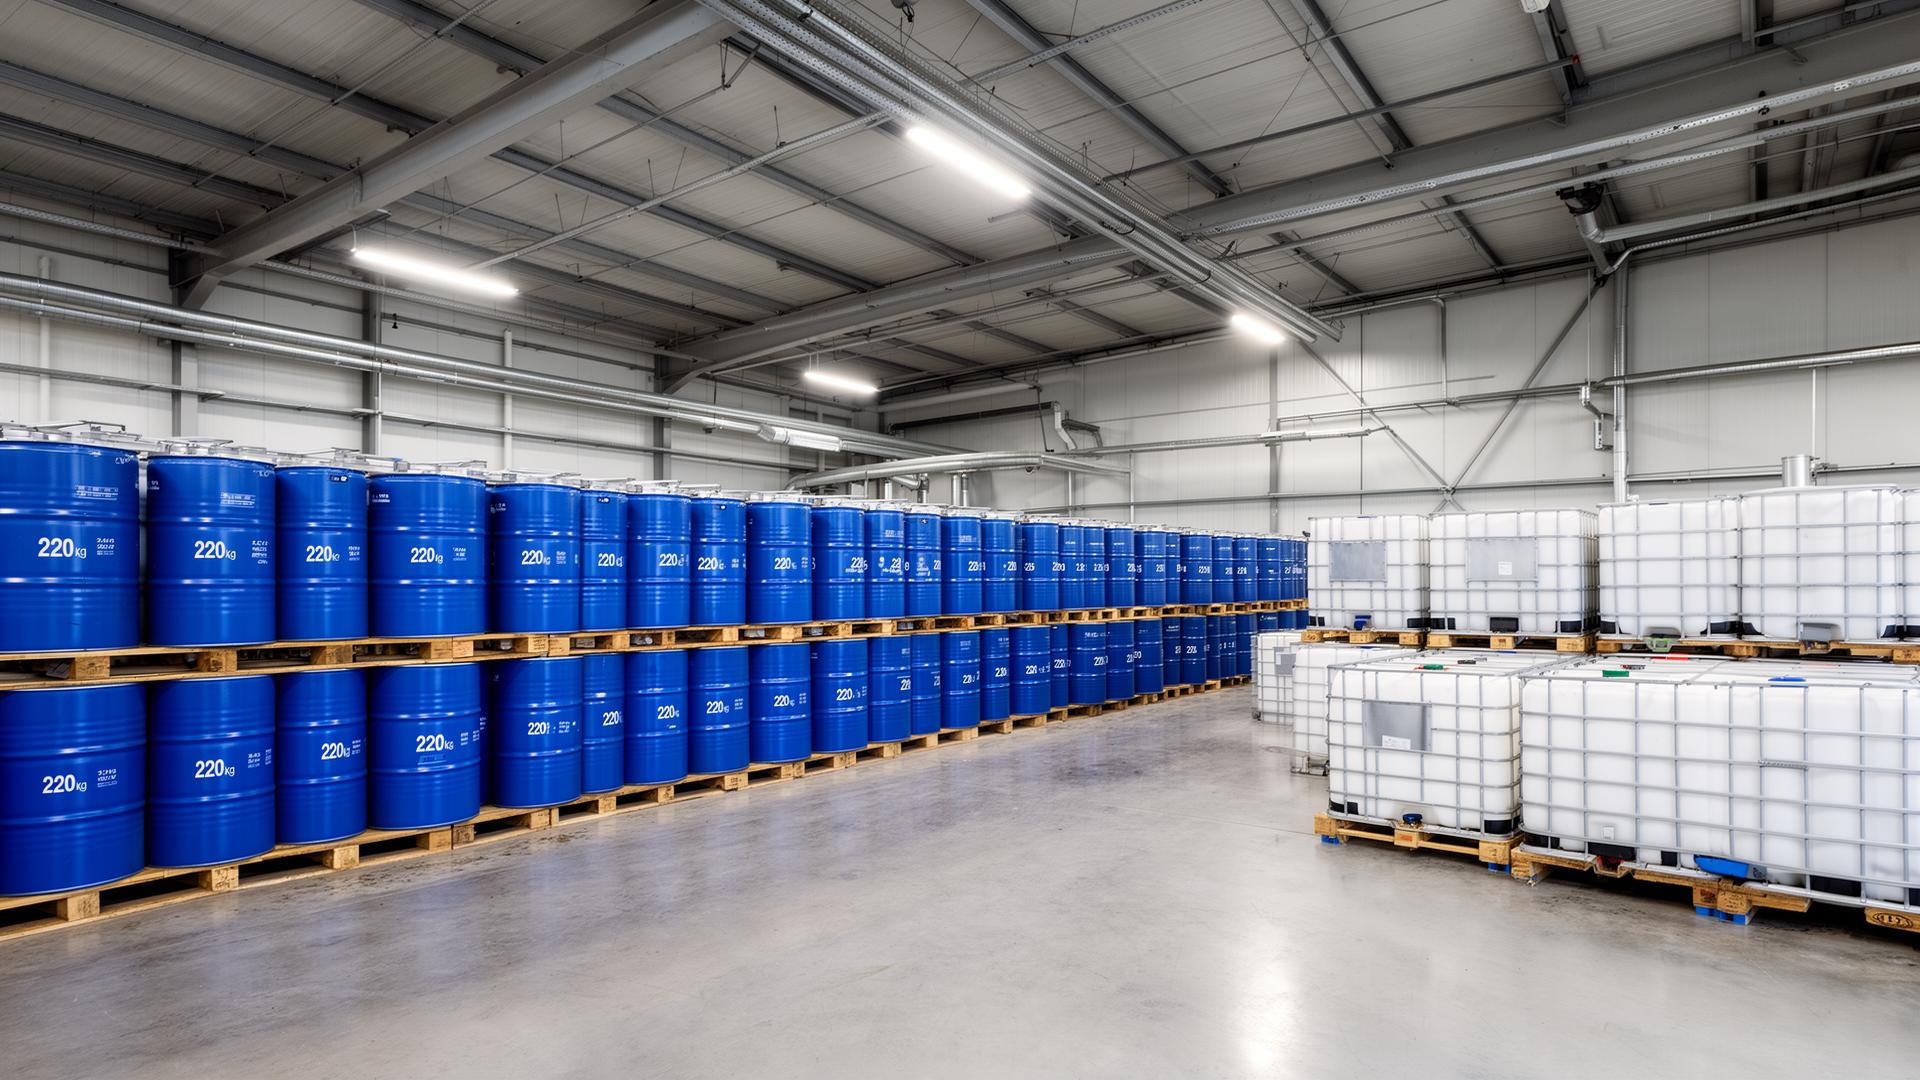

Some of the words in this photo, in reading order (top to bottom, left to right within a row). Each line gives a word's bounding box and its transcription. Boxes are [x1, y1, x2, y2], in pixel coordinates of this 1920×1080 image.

[38, 537, 86, 558] 220kg
[194, 540, 236, 560] 220kg
[194, 759, 235, 779] 220kg
[42, 774, 87, 794] 220kg
